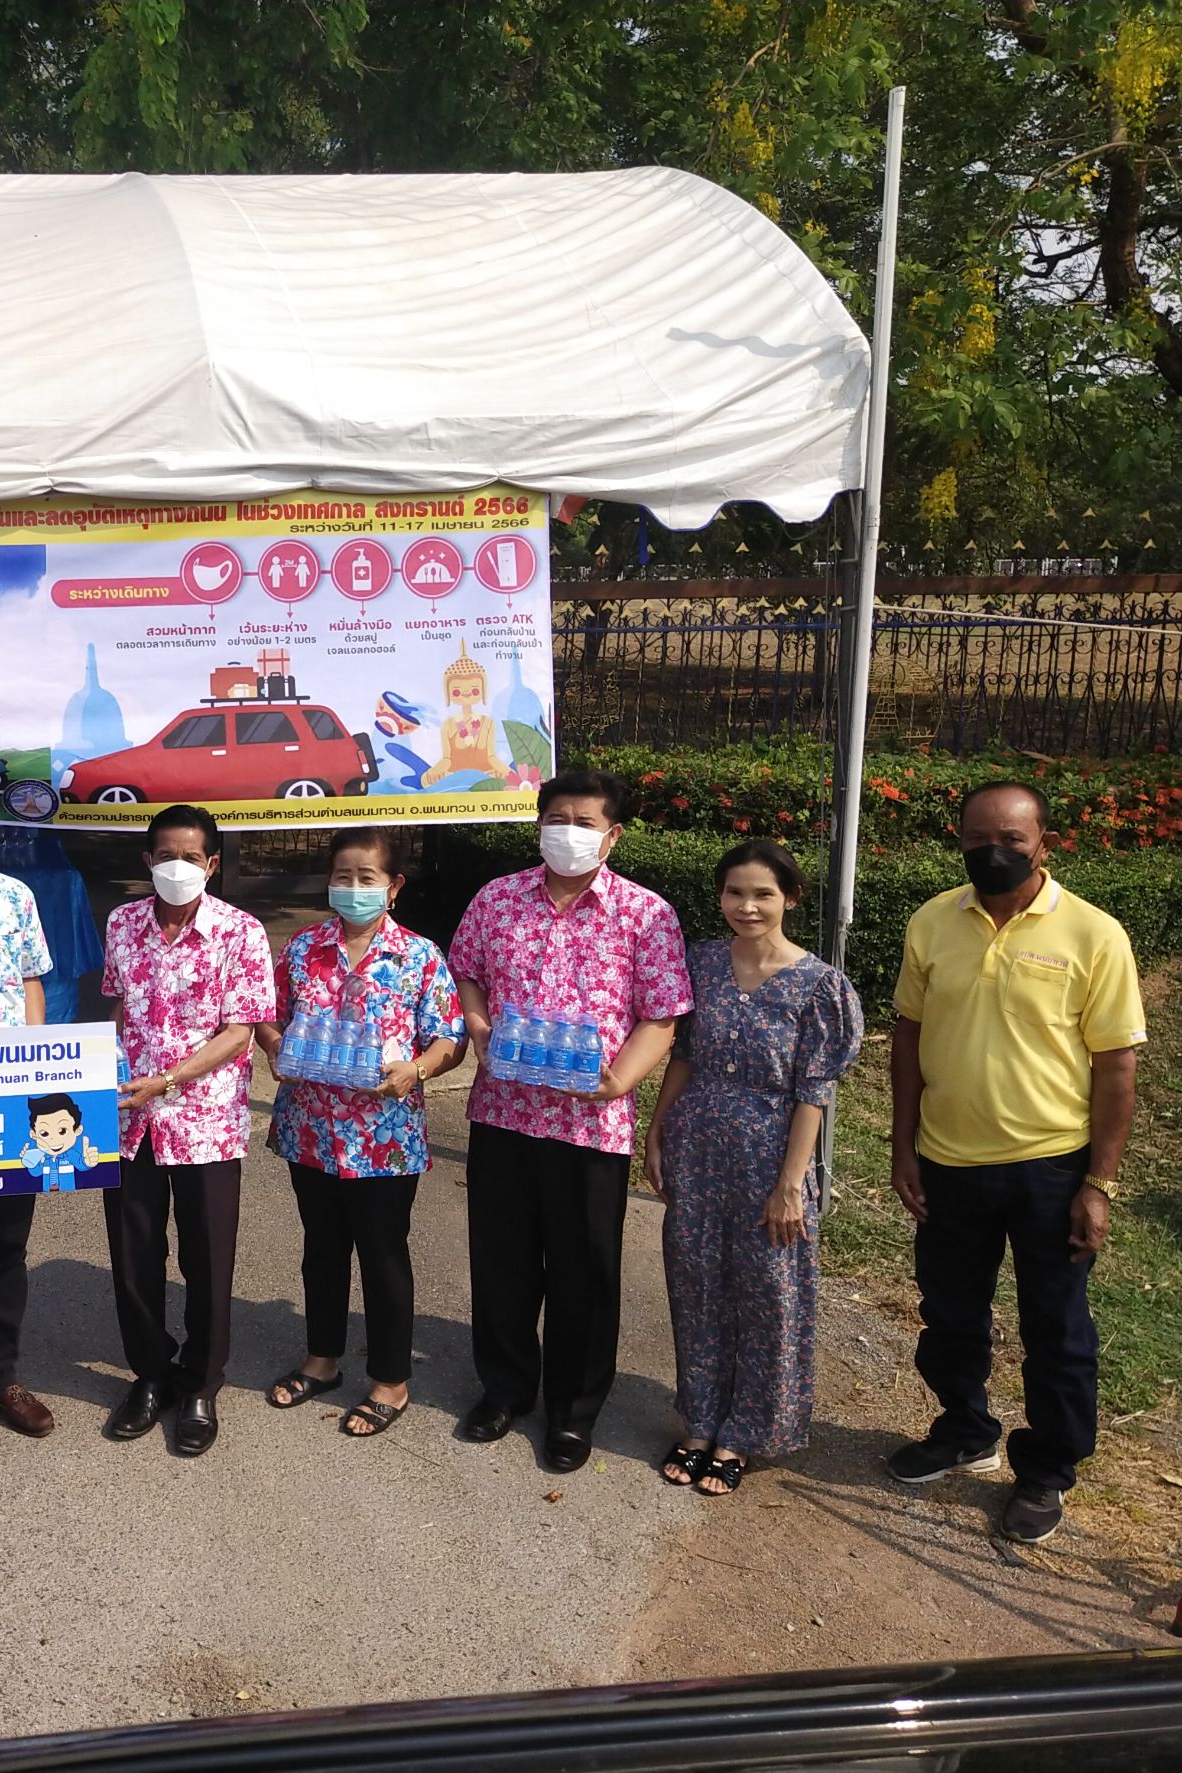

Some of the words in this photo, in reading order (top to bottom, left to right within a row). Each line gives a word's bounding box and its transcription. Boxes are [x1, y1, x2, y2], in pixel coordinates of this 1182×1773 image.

[374, 495, 465, 518] สงกรานต์
[474, 497, 529, 516] 2566
[290, 519, 373, 533] ระหว่างวันที่
[380, 521, 424, 531] 11-17
[431, 520, 484, 530] เมษายน
[491, 518, 530, 528] 2566
[69, 586, 170, 601] ระหว่างเดินทาง
[329, 617, 392, 631] หมั่นล้างมือ
[405, 618, 466, 629] แยกอาหาร
[476, 616, 507, 625] ตรวจ
[512, 614, 533, 624] ATK
[146, 624, 216, 636] สวมหน้ากาก
[239, 621, 308, 634] เว้นระยะห่าง
[479, 626, 535, 637] ก่อนกลับบ้าน
[227, 635, 272, 646] อย่างน้อย
[275, 636, 291, 645] 1-2
[294, 636, 317, 645] เมตร
[421, 631, 452, 641] เป็นชุด
[116, 638, 217, 649] ตลอดเวลาการเดินทาง
[473, 639, 542, 649] และก่อนกลับเข้า
[327, 644, 396, 655] เจลแอลกอฮอล์
[495, 650, 523, 660] ทำงาน
[410, 803, 476, 815] อ.พนมทวน
[35, 1069, 82, 1082] Branch
